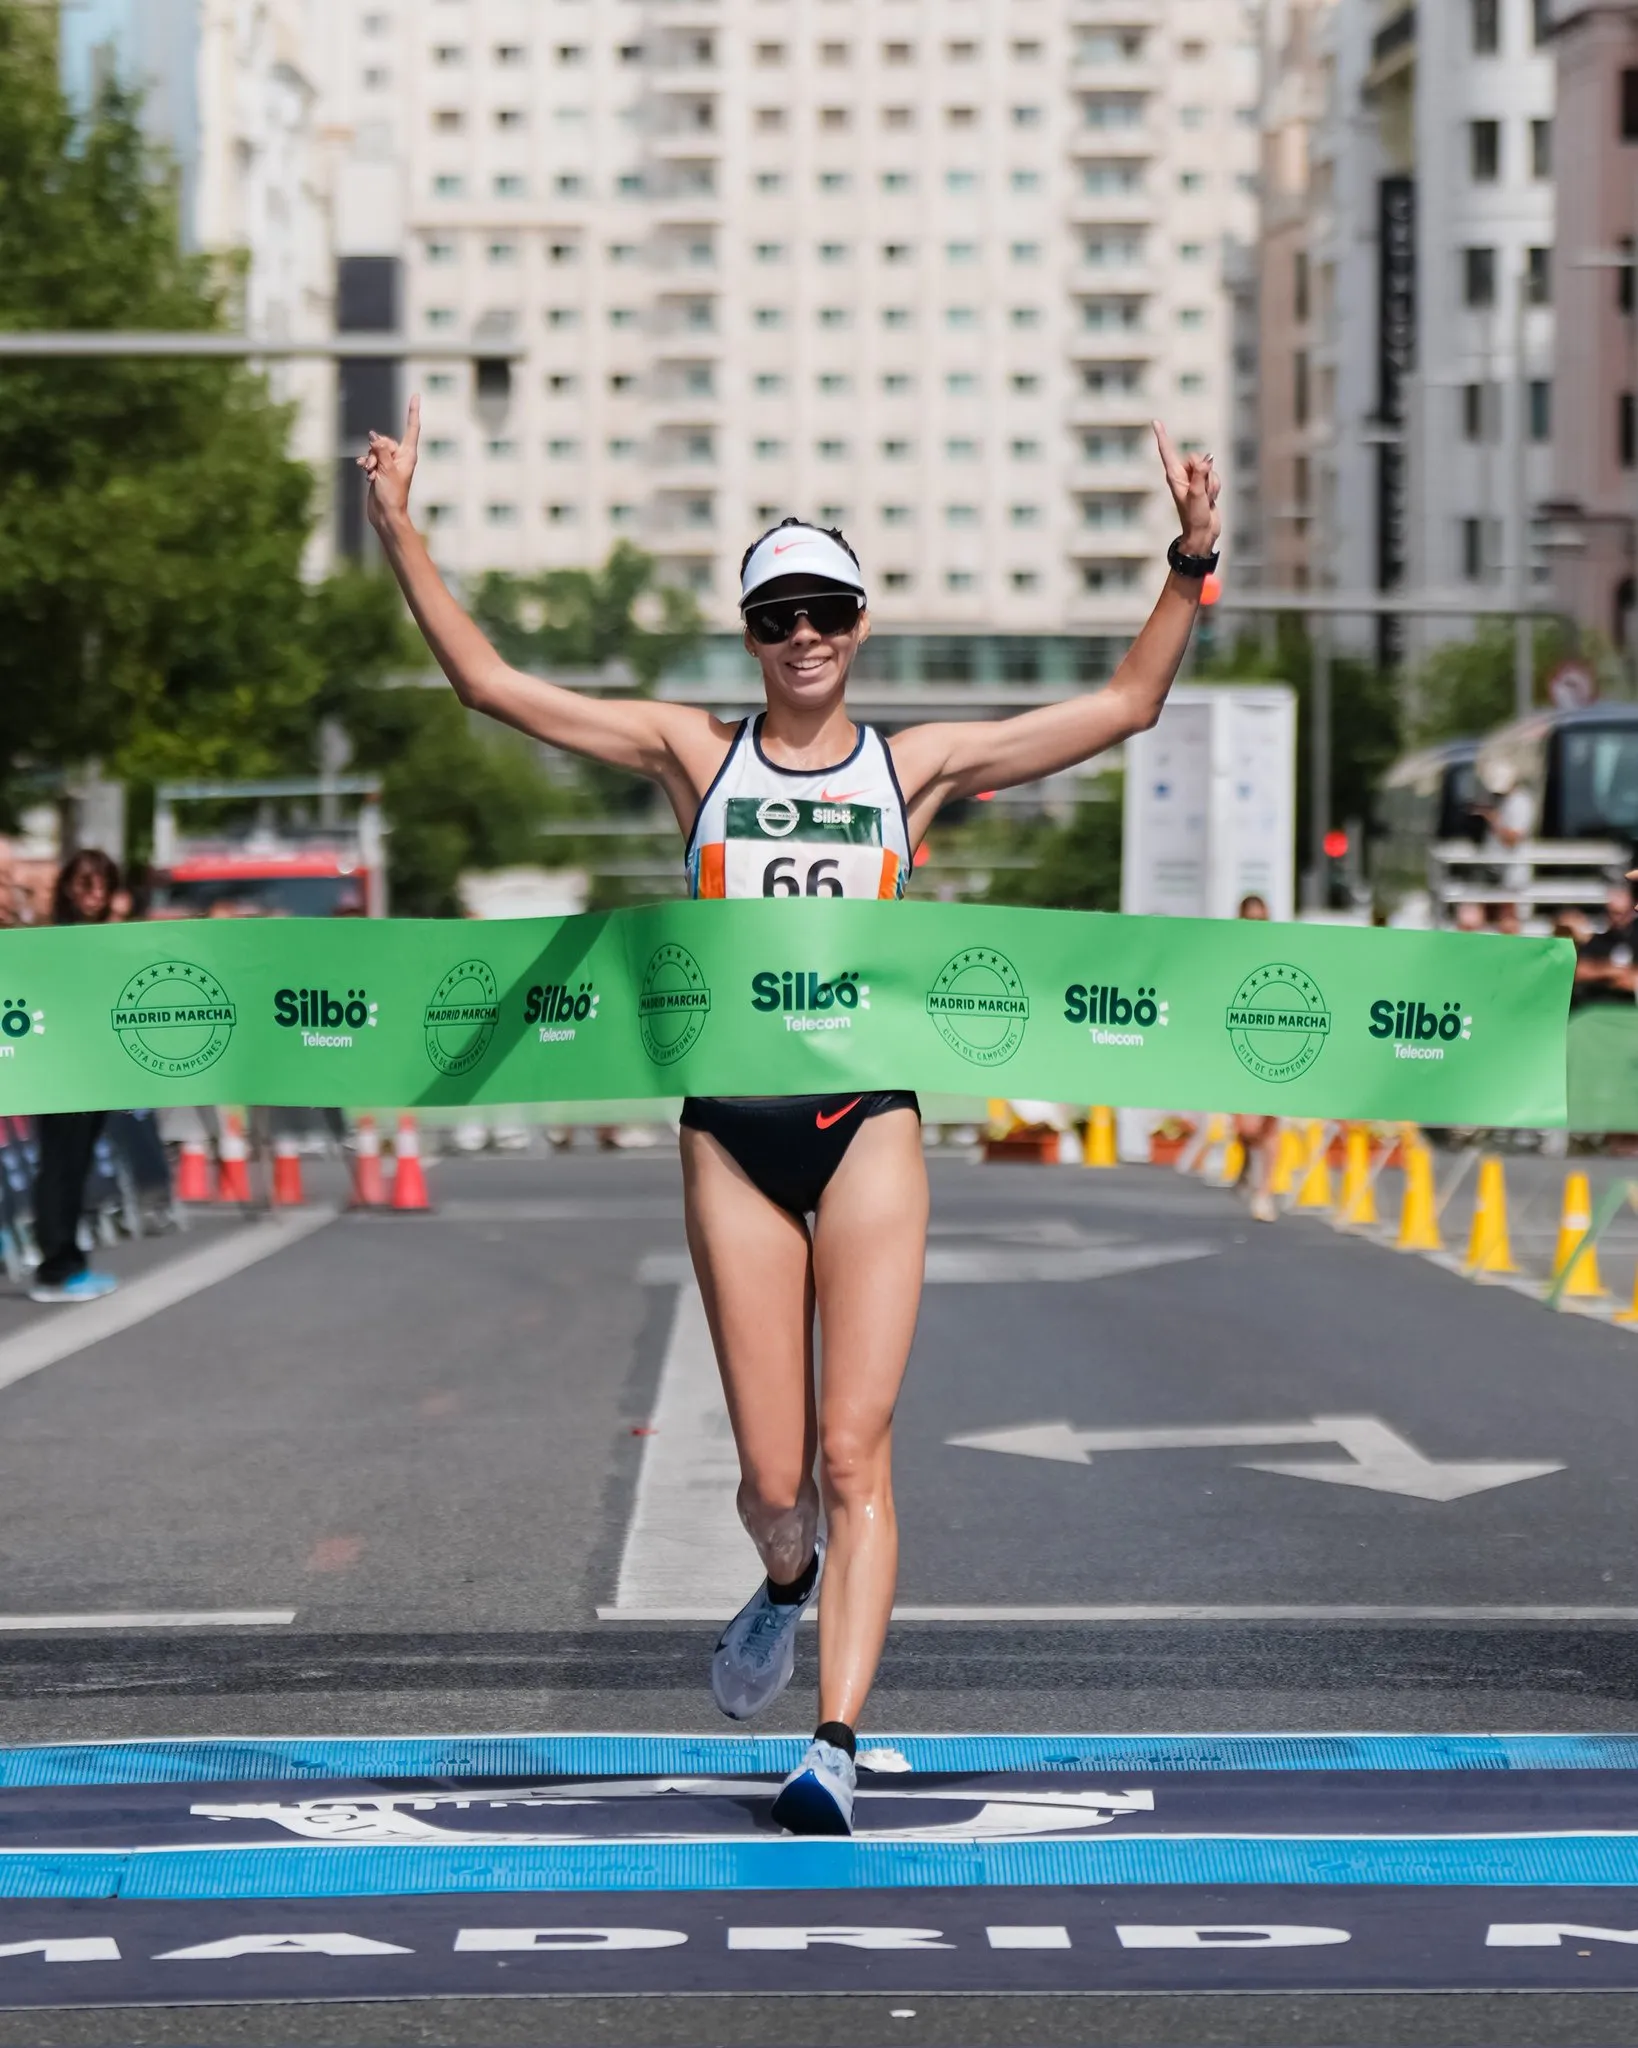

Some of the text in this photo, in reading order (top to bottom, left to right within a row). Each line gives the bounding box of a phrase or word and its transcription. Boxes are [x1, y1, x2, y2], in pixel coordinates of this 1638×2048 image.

[763, 857, 844, 898] 66
[751, 970, 860, 1013] Silbö
[273, 988, 368, 1029] Silbö
[523, 982, 593, 1025] Silbö
[641, 994, 707, 1009] MADRID MARCHA
[930, 997, 1026, 1013] MADRID MARCHA
[1063, 984, 1158, 1028] Silbö
[116, 1009, 233, 1025] MADRID MARCHA
[427, 1007, 497, 1022] MADRID MARCHA
[783, 1014, 852, 1032] Telecom
[1229, 1012, 1327, 1029] MADRID MARCHA
[1368, 999, 1462, 1042] Silbö
[301, 1031, 353, 1048] Telecom
[539, 1027, 576, 1043] Telecom
[1089, 1028, 1144, 1047] Telecom
[129, 1039, 223, 1072] CITA DE CAMPEONES
[1393, 1043, 1445, 1060] Telecom
[1238, 1044, 1315, 1078] CITA DE CAMPEONES
